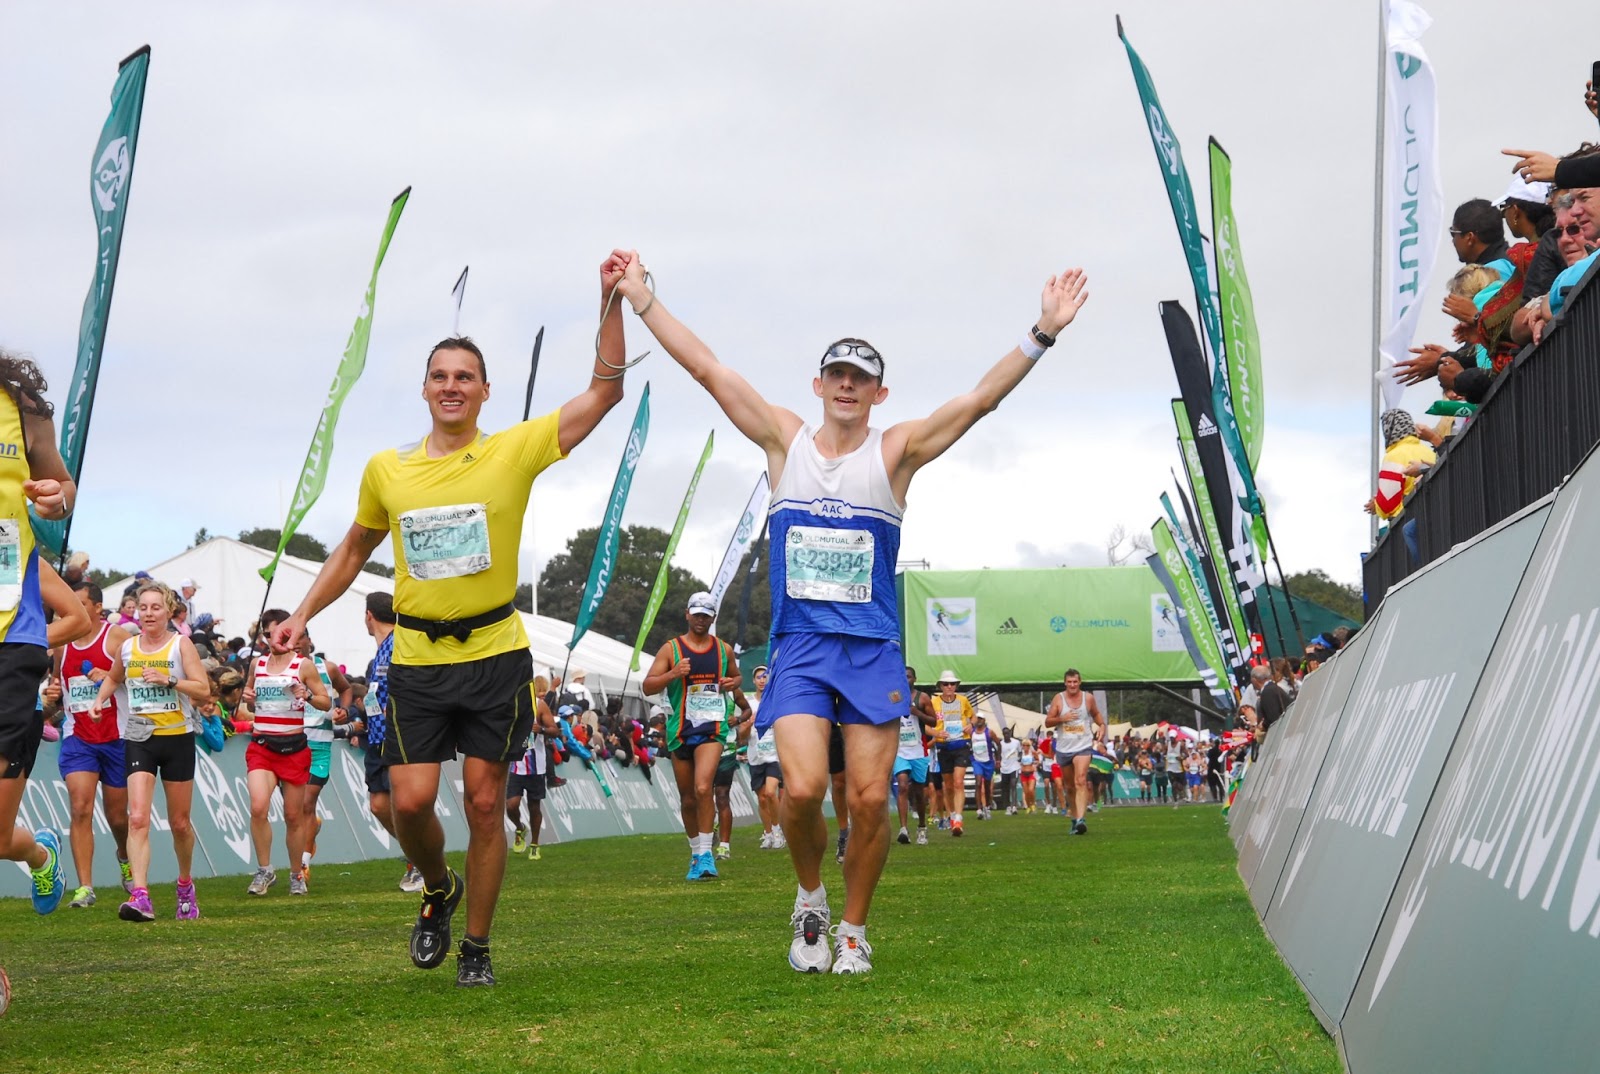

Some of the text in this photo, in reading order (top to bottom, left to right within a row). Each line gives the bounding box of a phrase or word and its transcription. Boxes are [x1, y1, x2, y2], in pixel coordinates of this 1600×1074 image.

[822, 504, 843, 514] AAC
[415, 512, 462, 523] OLDMUTUAL
[804, 535, 850, 545] OLDMUTUAL
[792, 548, 865, 573] C23934
[846, 584, 868, 601] 40
[1070, 619, 1130, 628] OLDMUTUAL
[257, 687, 286, 697] D3025
[163, 702, 177, 710] 40
